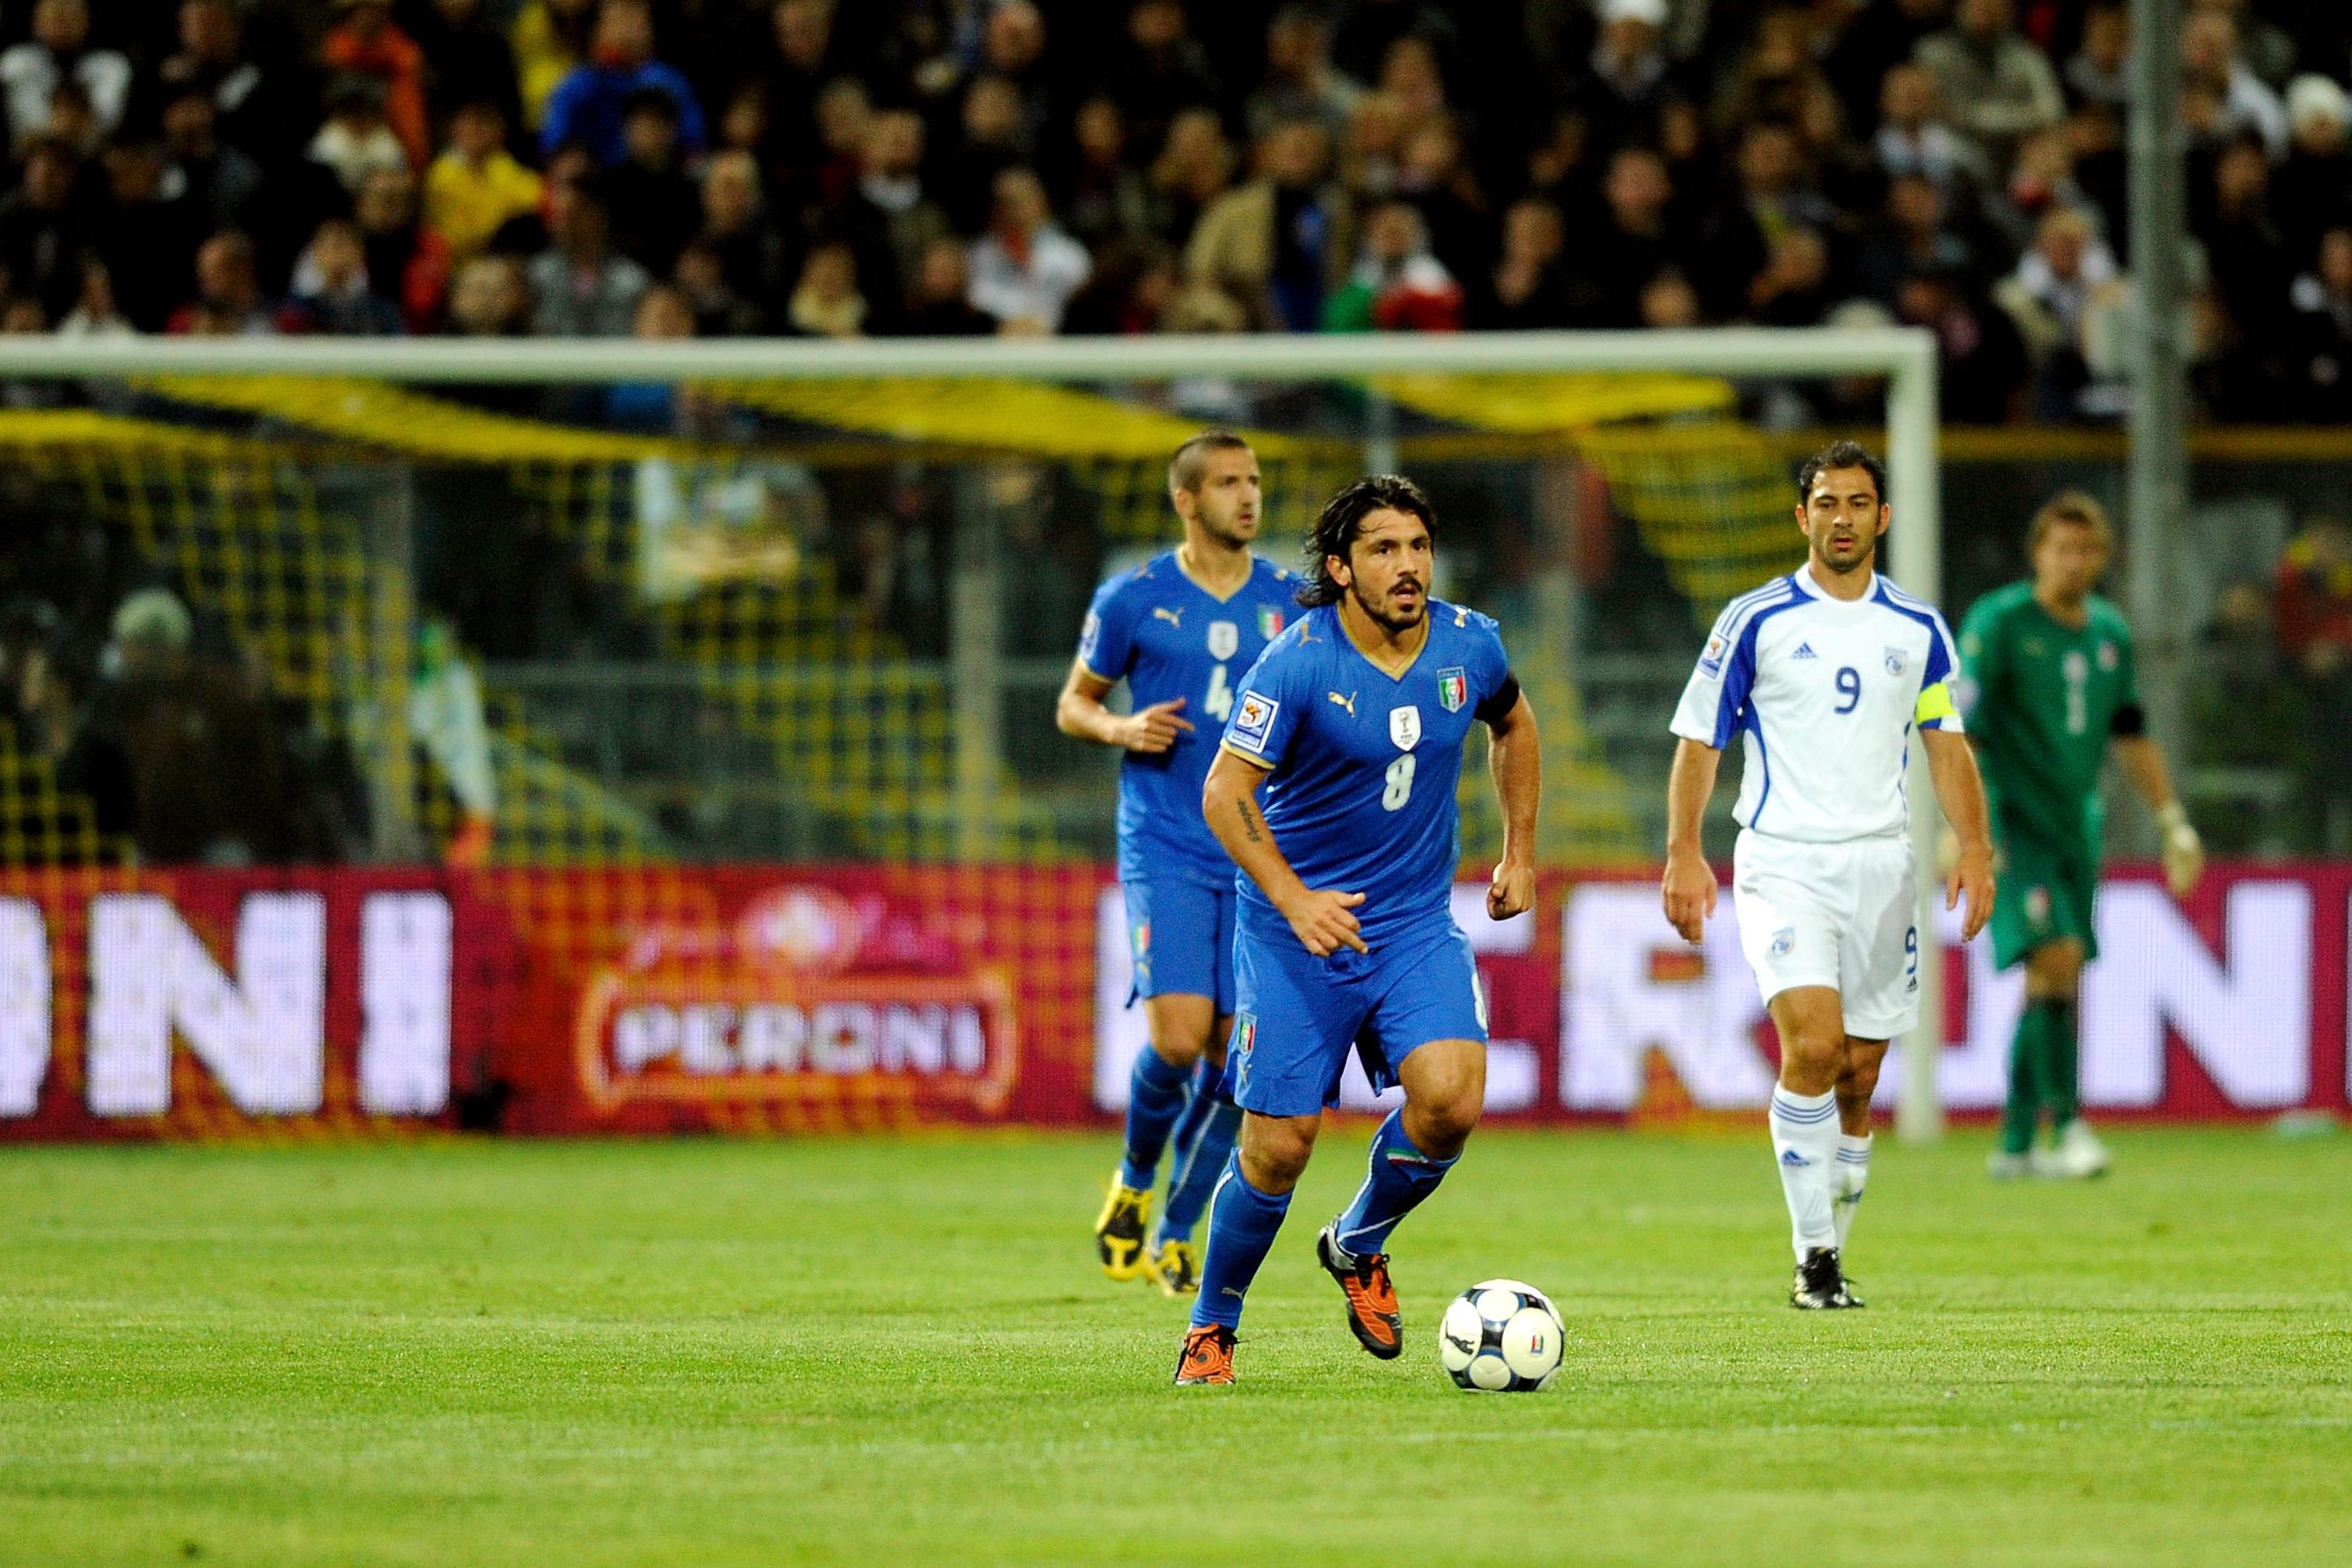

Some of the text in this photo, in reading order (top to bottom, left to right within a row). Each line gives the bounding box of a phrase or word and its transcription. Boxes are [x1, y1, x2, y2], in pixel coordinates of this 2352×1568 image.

[1205, 664, 1234, 722] 4
[1833, 666, 1862, 715] 9
[1382, 753, 1417, 812] 8
[1905, 925, 1918, 975] 9
[0, 889, 452, 1116] NI
